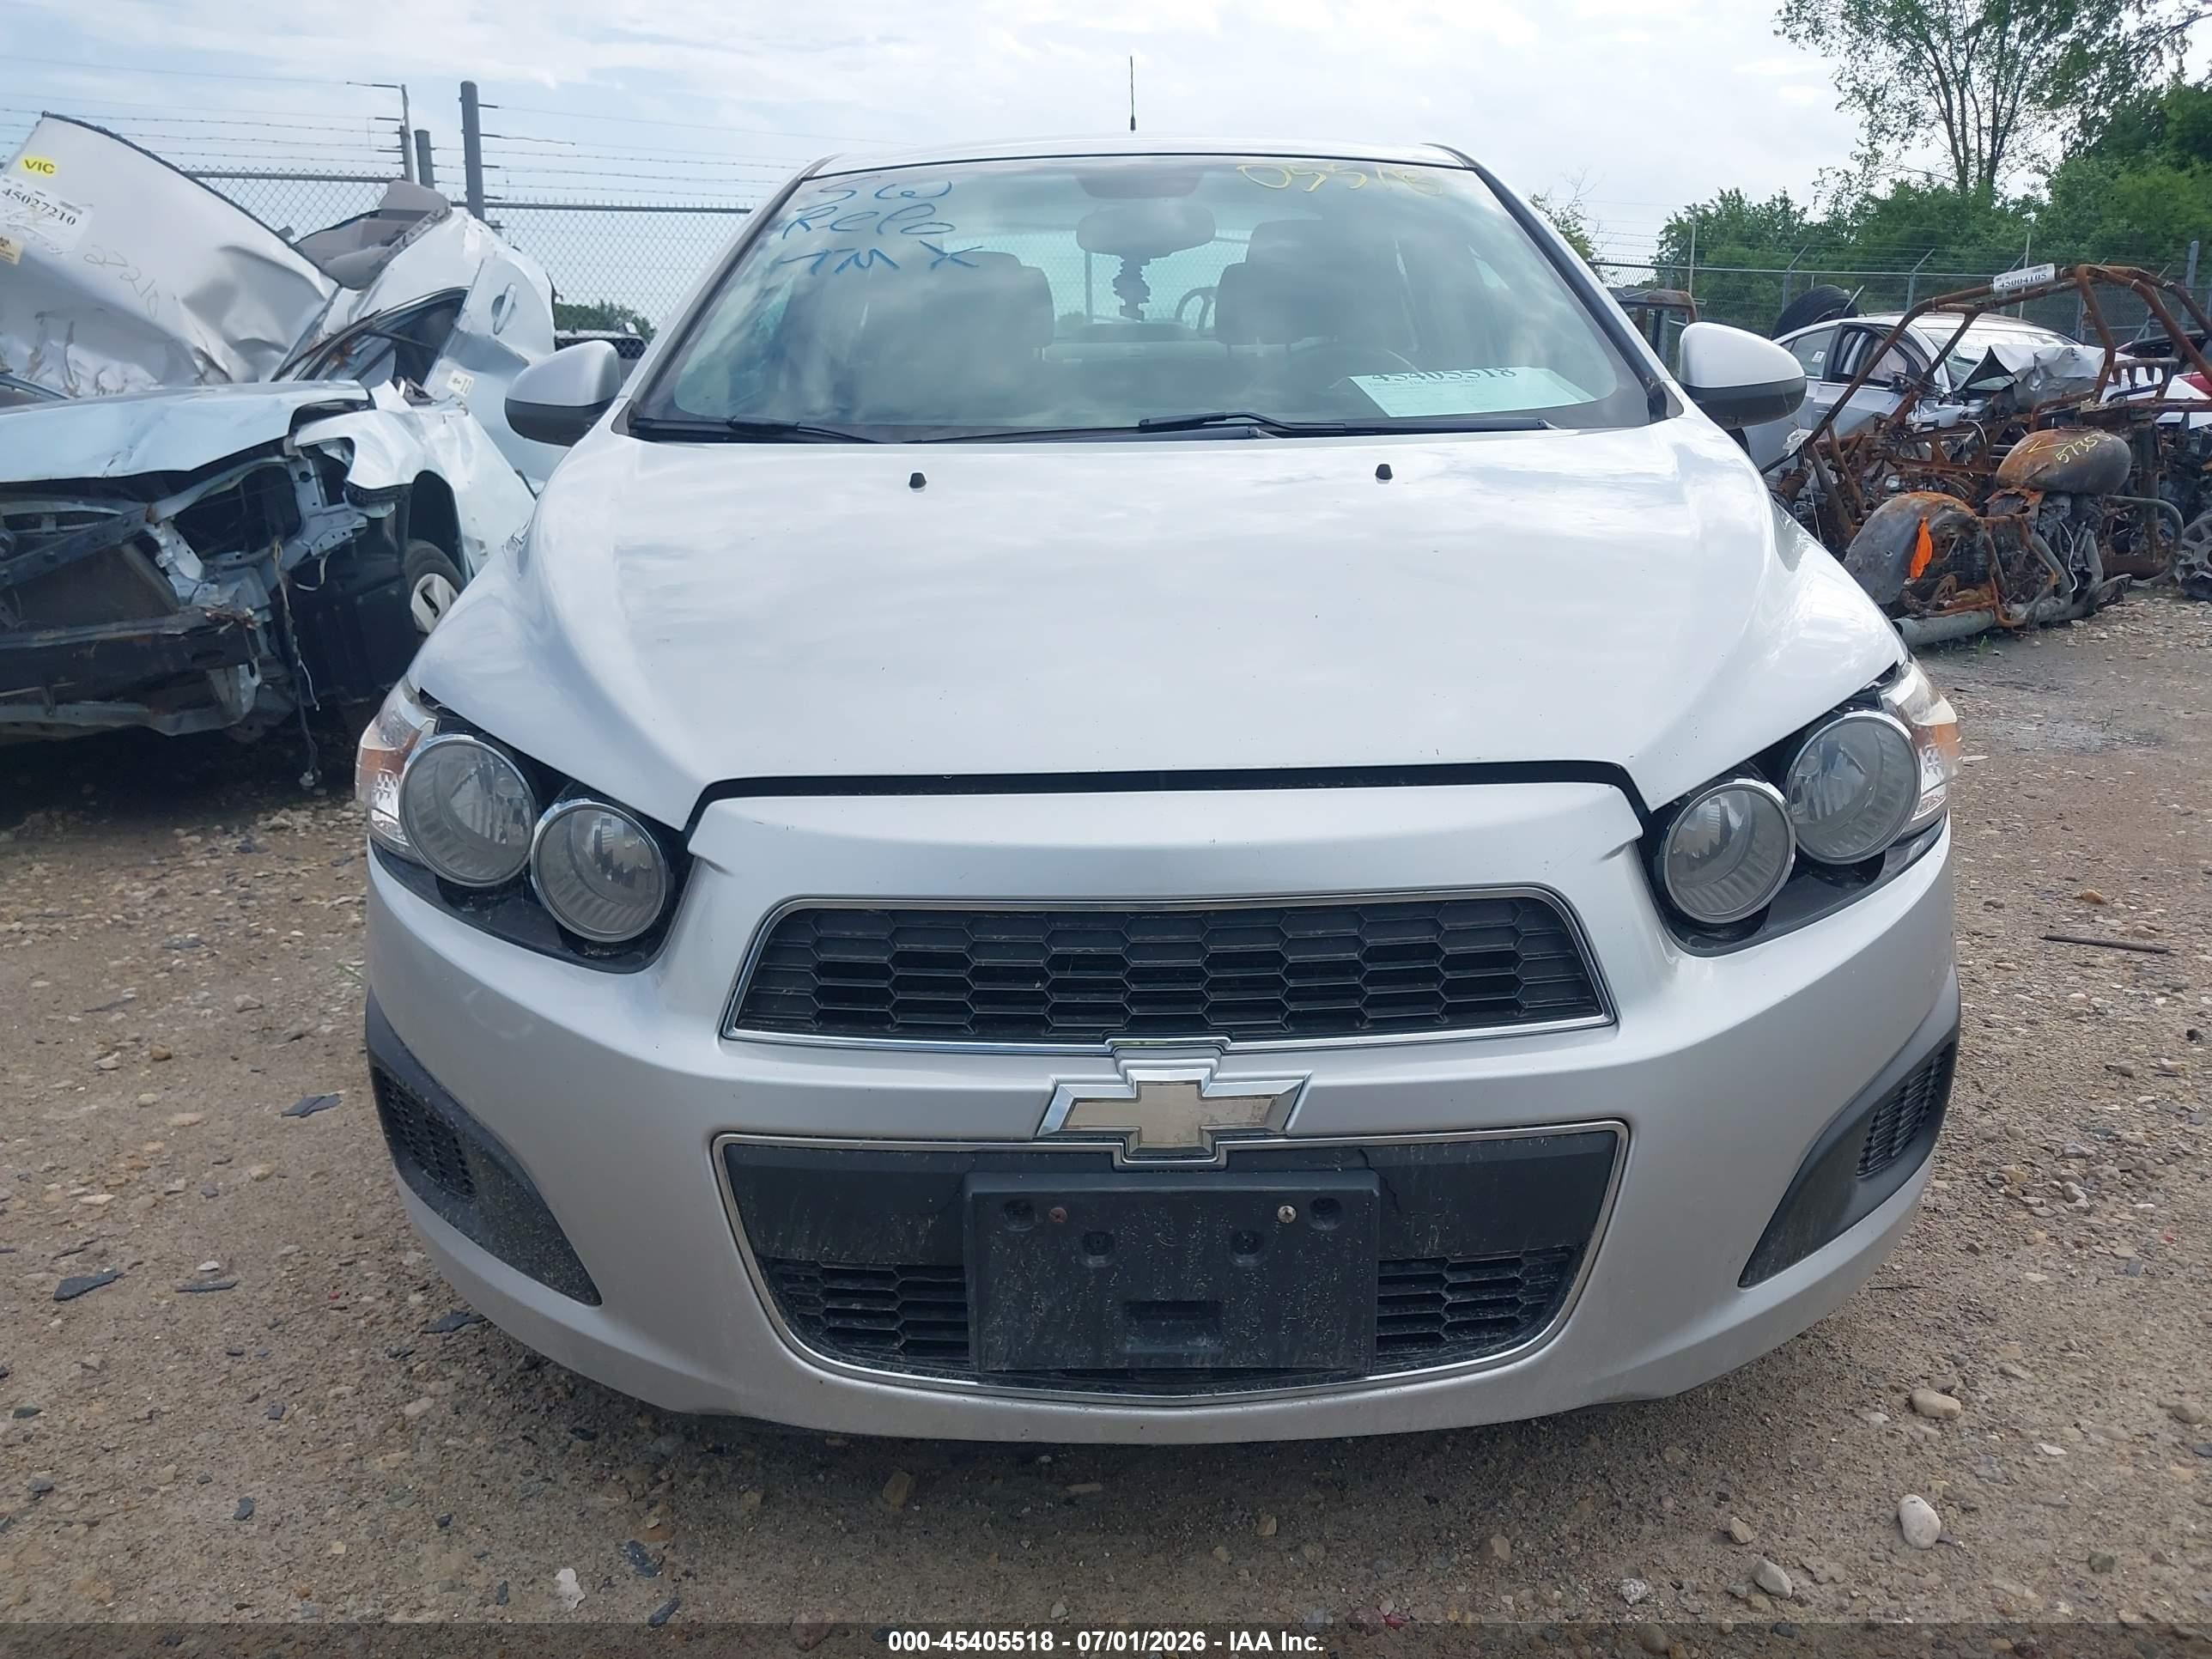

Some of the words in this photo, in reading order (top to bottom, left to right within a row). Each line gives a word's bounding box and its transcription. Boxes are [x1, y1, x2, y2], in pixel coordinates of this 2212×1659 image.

[24, 159, 56, 174] VIC
[2, 188, 76, 226] 45027210
[1998, 274, 2047, 289] 45004105
